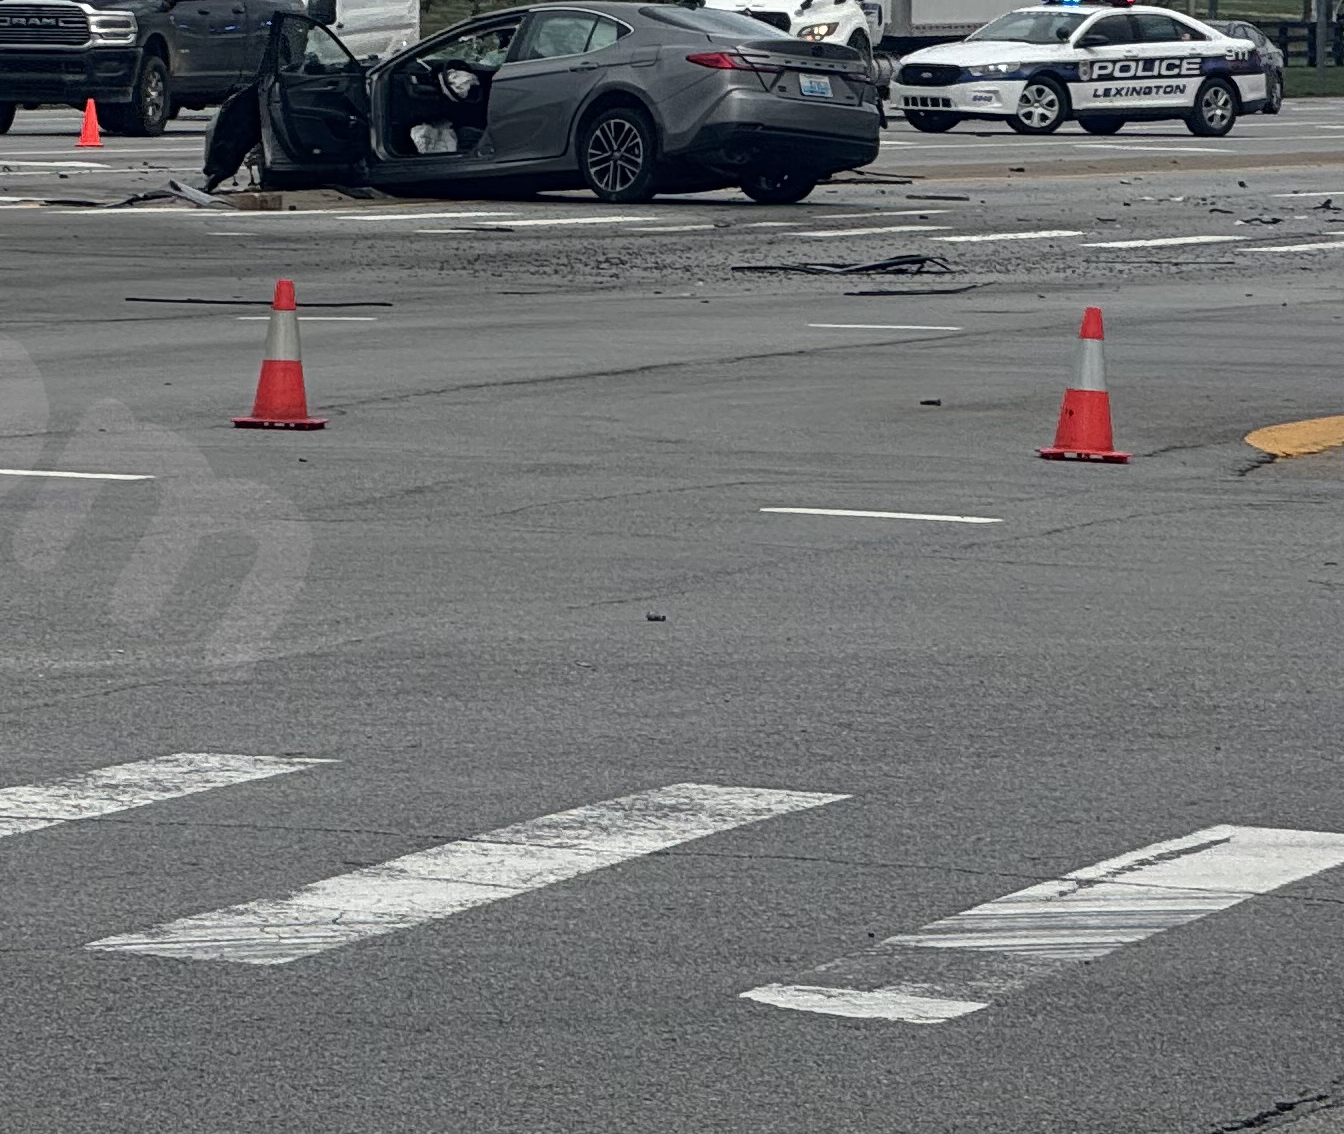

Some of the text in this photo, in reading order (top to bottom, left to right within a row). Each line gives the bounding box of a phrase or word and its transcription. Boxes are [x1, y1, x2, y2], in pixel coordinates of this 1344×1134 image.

[12, 17, 58, 27] RAM
[1225, 46, 1249, 61] 911
[1091, 58, 1202, 79] POLICE
[1092, 83, 1188, 99] LEXINGTON
